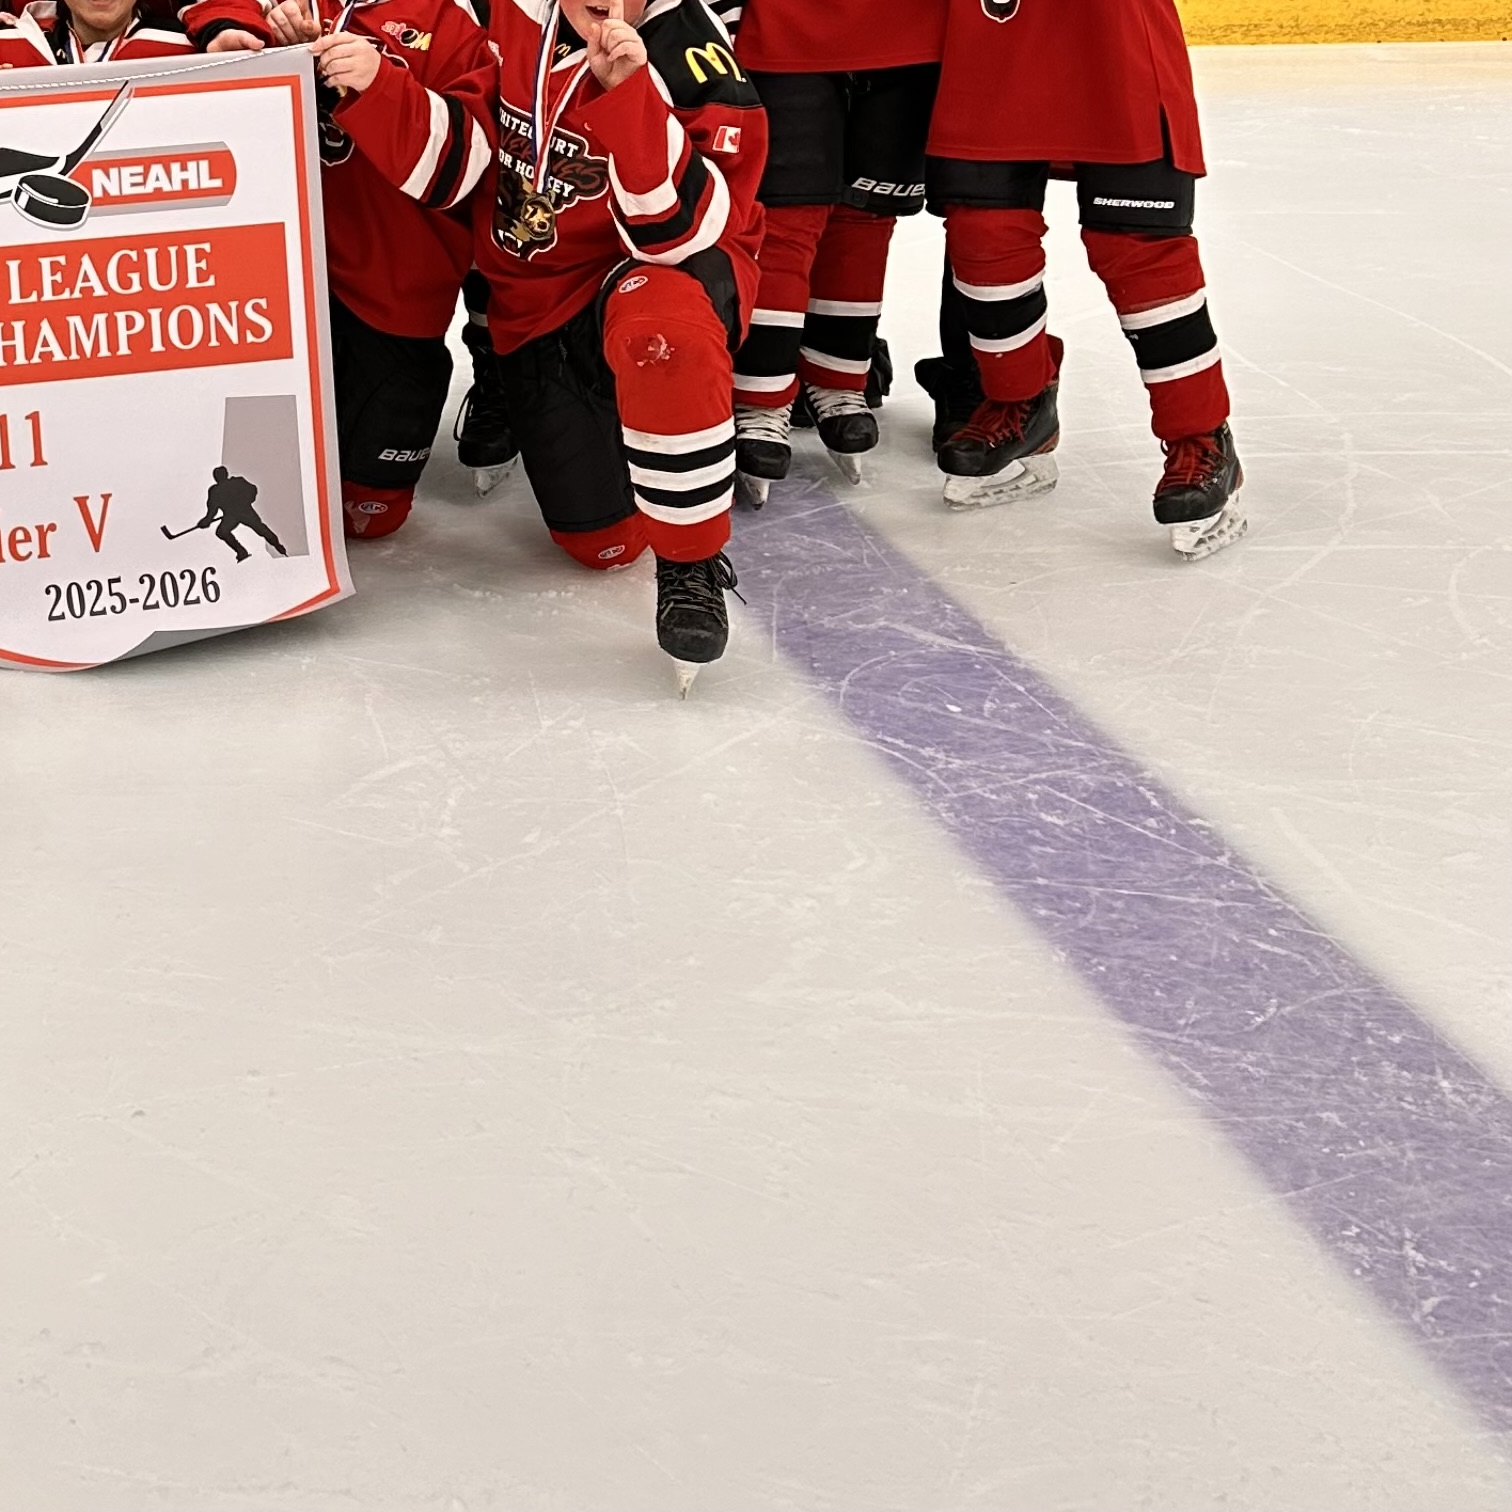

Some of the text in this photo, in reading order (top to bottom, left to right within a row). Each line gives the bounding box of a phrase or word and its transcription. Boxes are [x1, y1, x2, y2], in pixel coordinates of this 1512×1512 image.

[91, 159, 223, 198] NEAHL
[1092, 196, 1175, 210] SHERWOOD
[6, 242, 217, 305] LEAGUE
[72, 492, 114, 554] V
[44, 565, 222, 623] 2025-2026
